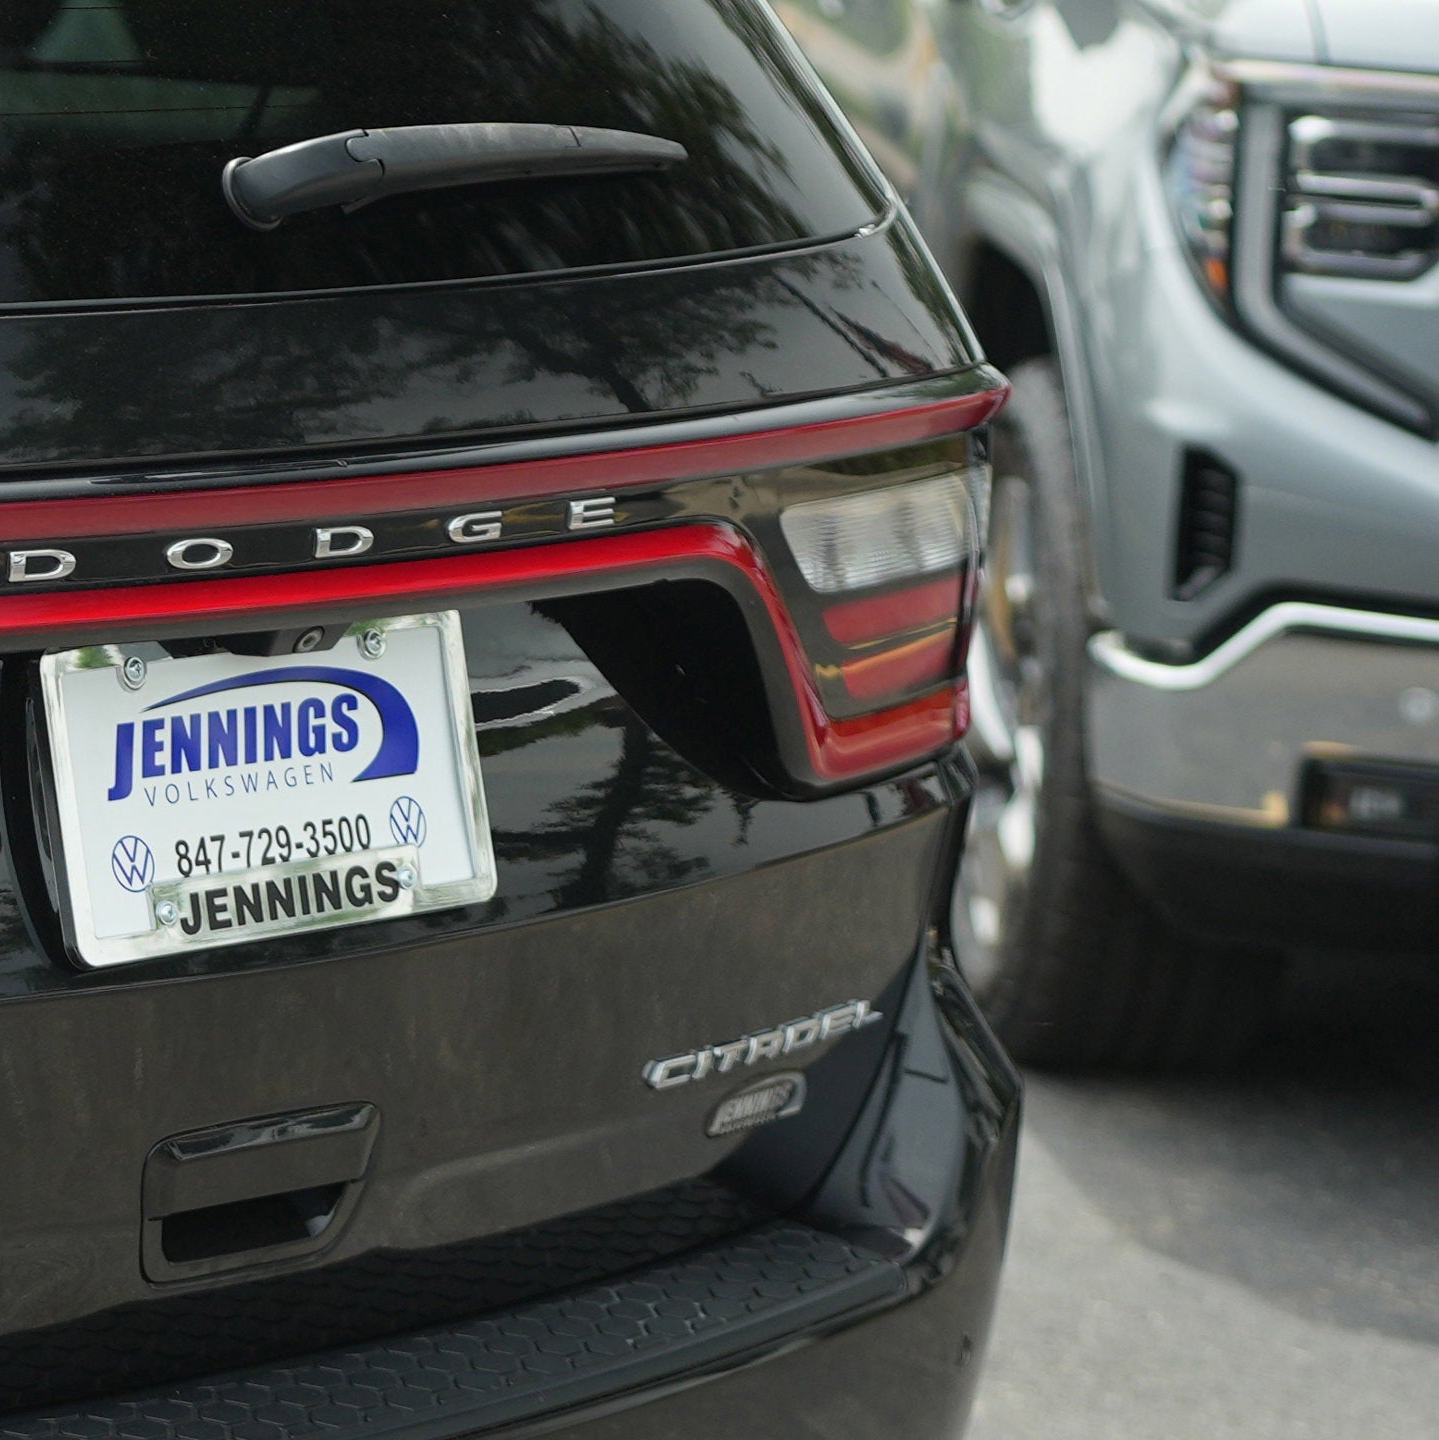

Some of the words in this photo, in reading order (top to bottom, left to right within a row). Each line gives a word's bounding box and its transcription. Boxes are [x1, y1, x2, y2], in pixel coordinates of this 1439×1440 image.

[8, 496, 617, 584] DODGE
[108, 693, 360, 802] JENNINGS
[143, 761, 336, 808] VOLKSWAGEN
[174, 813, 372, 878] 847-729-3500
[179, 860, 401, 936] JENNINGS
[641, 998, 884, 1090] CITADEL
